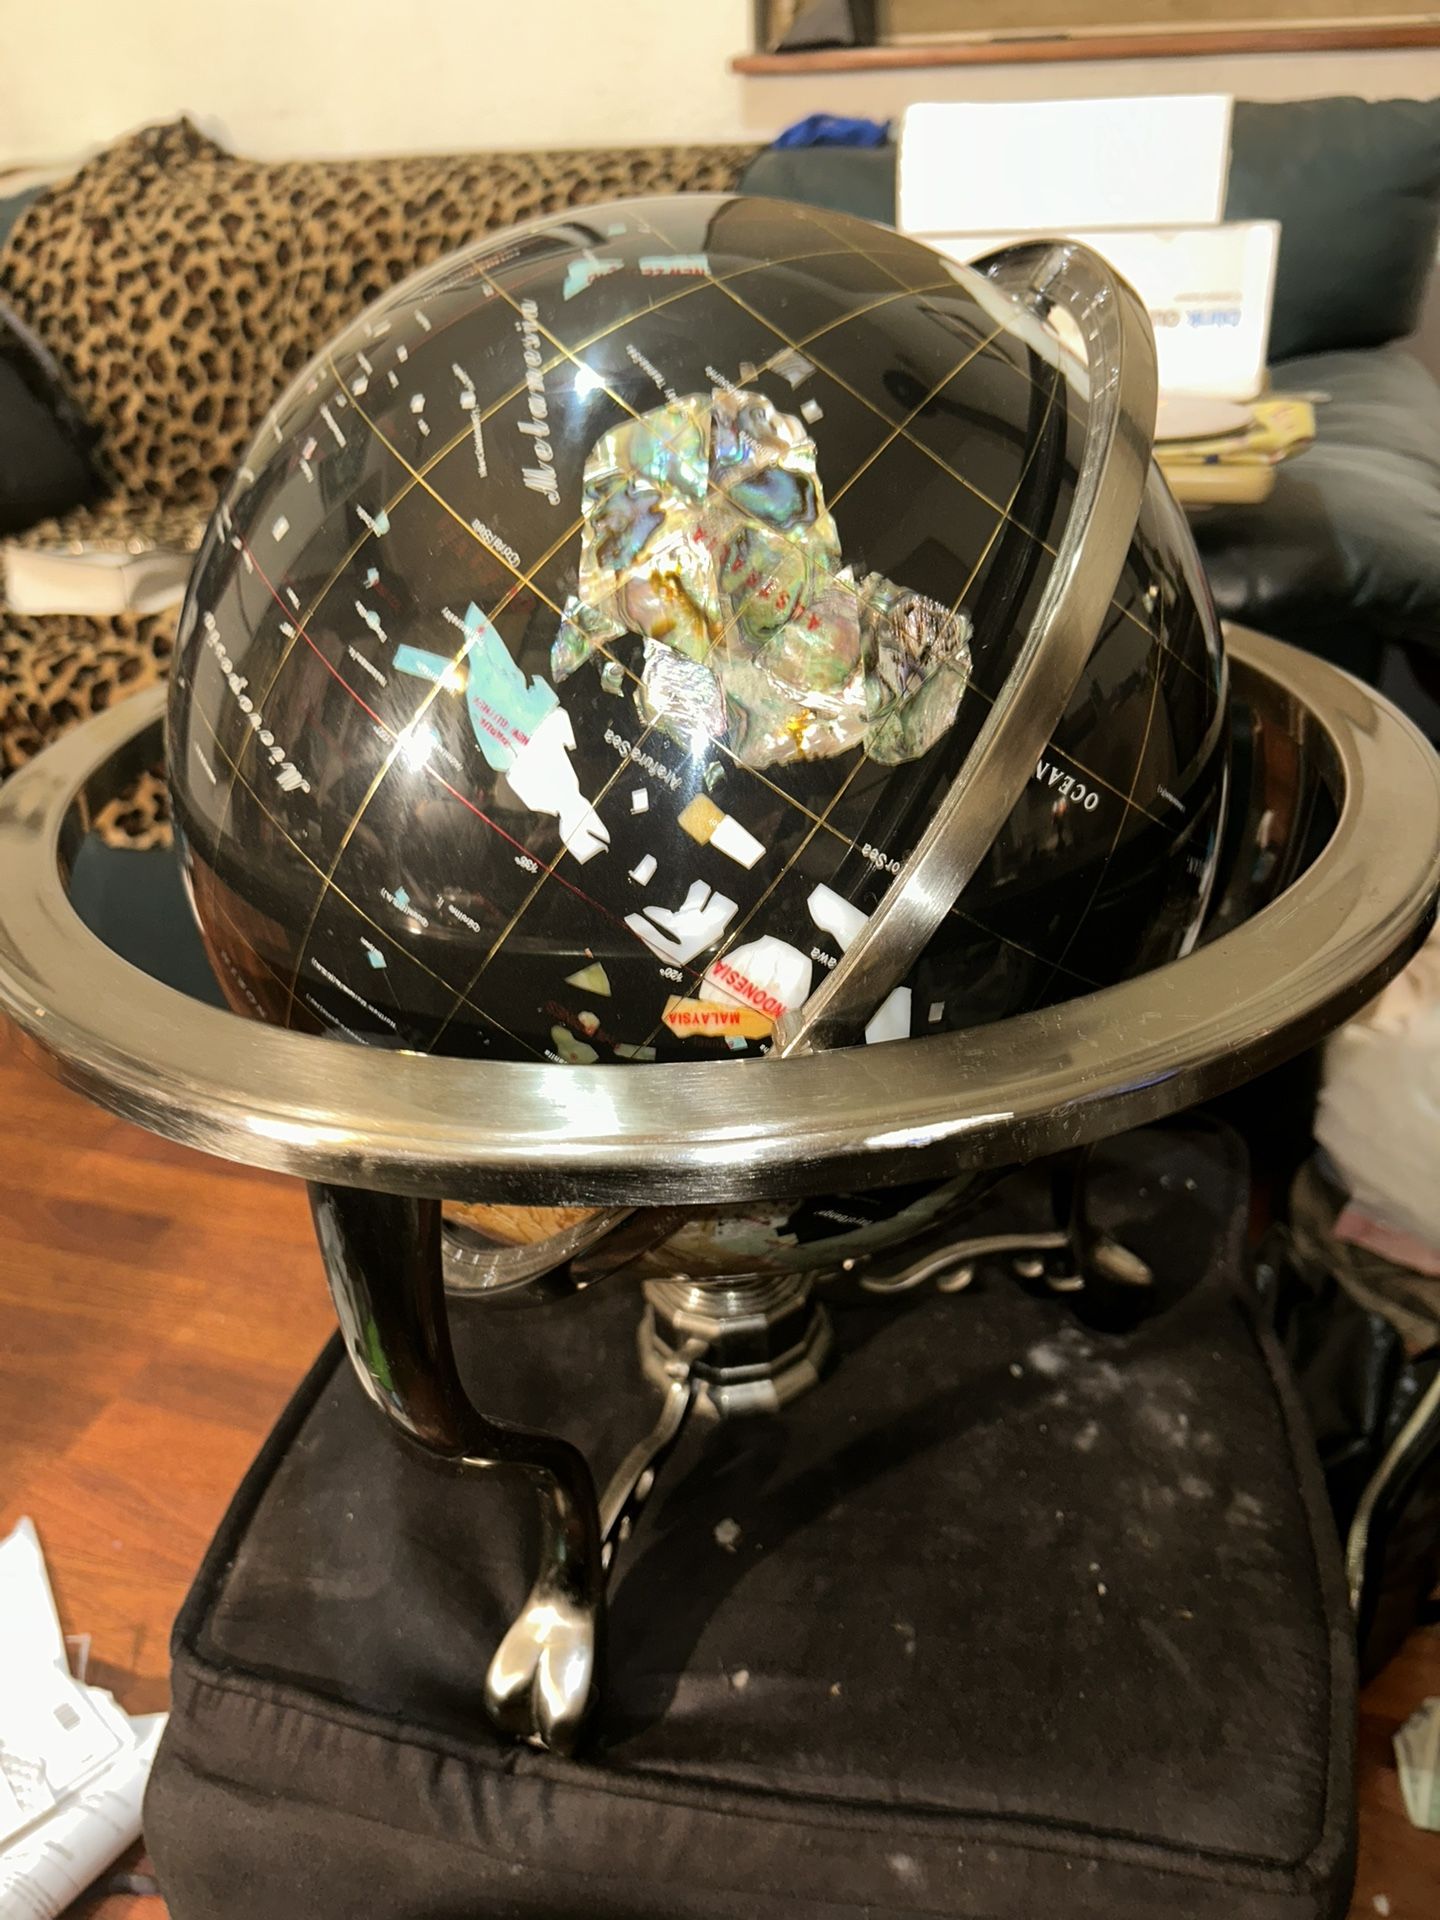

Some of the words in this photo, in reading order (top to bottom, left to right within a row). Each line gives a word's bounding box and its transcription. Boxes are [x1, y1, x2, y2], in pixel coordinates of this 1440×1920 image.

[516, 299, 561, 506] Melanesia
[692, 525, 820, 634] AUSTRALIA
[202, 612, 311, 794] Micronesia
[603, 727, 632, 759] Sea
[626, 744, 683, 793] Arafura
[1033, 760, 1101, 811] OCEAN
[861, 841, 888, 867] Sea
[810, 946, 838, 970] awa
[711, 959, 788, 1019] NDONESIA
[667, 1010, 742, 1026] MALAYSIA
[543, 1047, 568, 1066] anila
